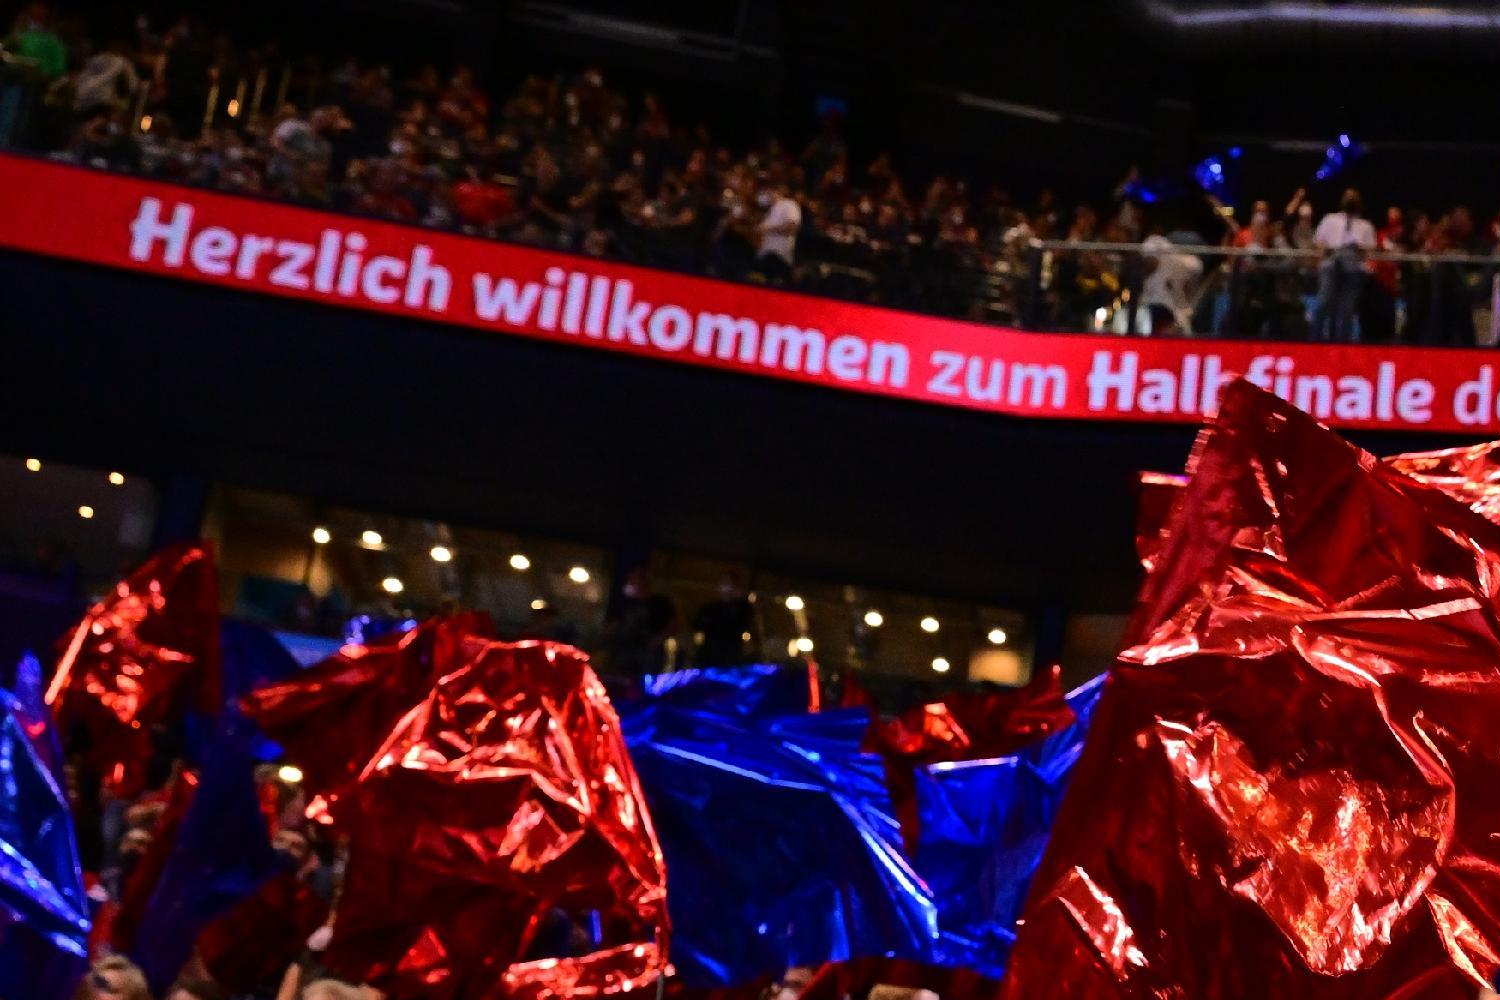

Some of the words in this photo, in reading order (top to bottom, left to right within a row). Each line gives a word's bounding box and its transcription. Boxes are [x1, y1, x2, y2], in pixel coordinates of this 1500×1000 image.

[130, 197, 450, 312] Herzlich
[473, 266, 911, 388] willkommen
[926, 349, 1068, 408] zum
